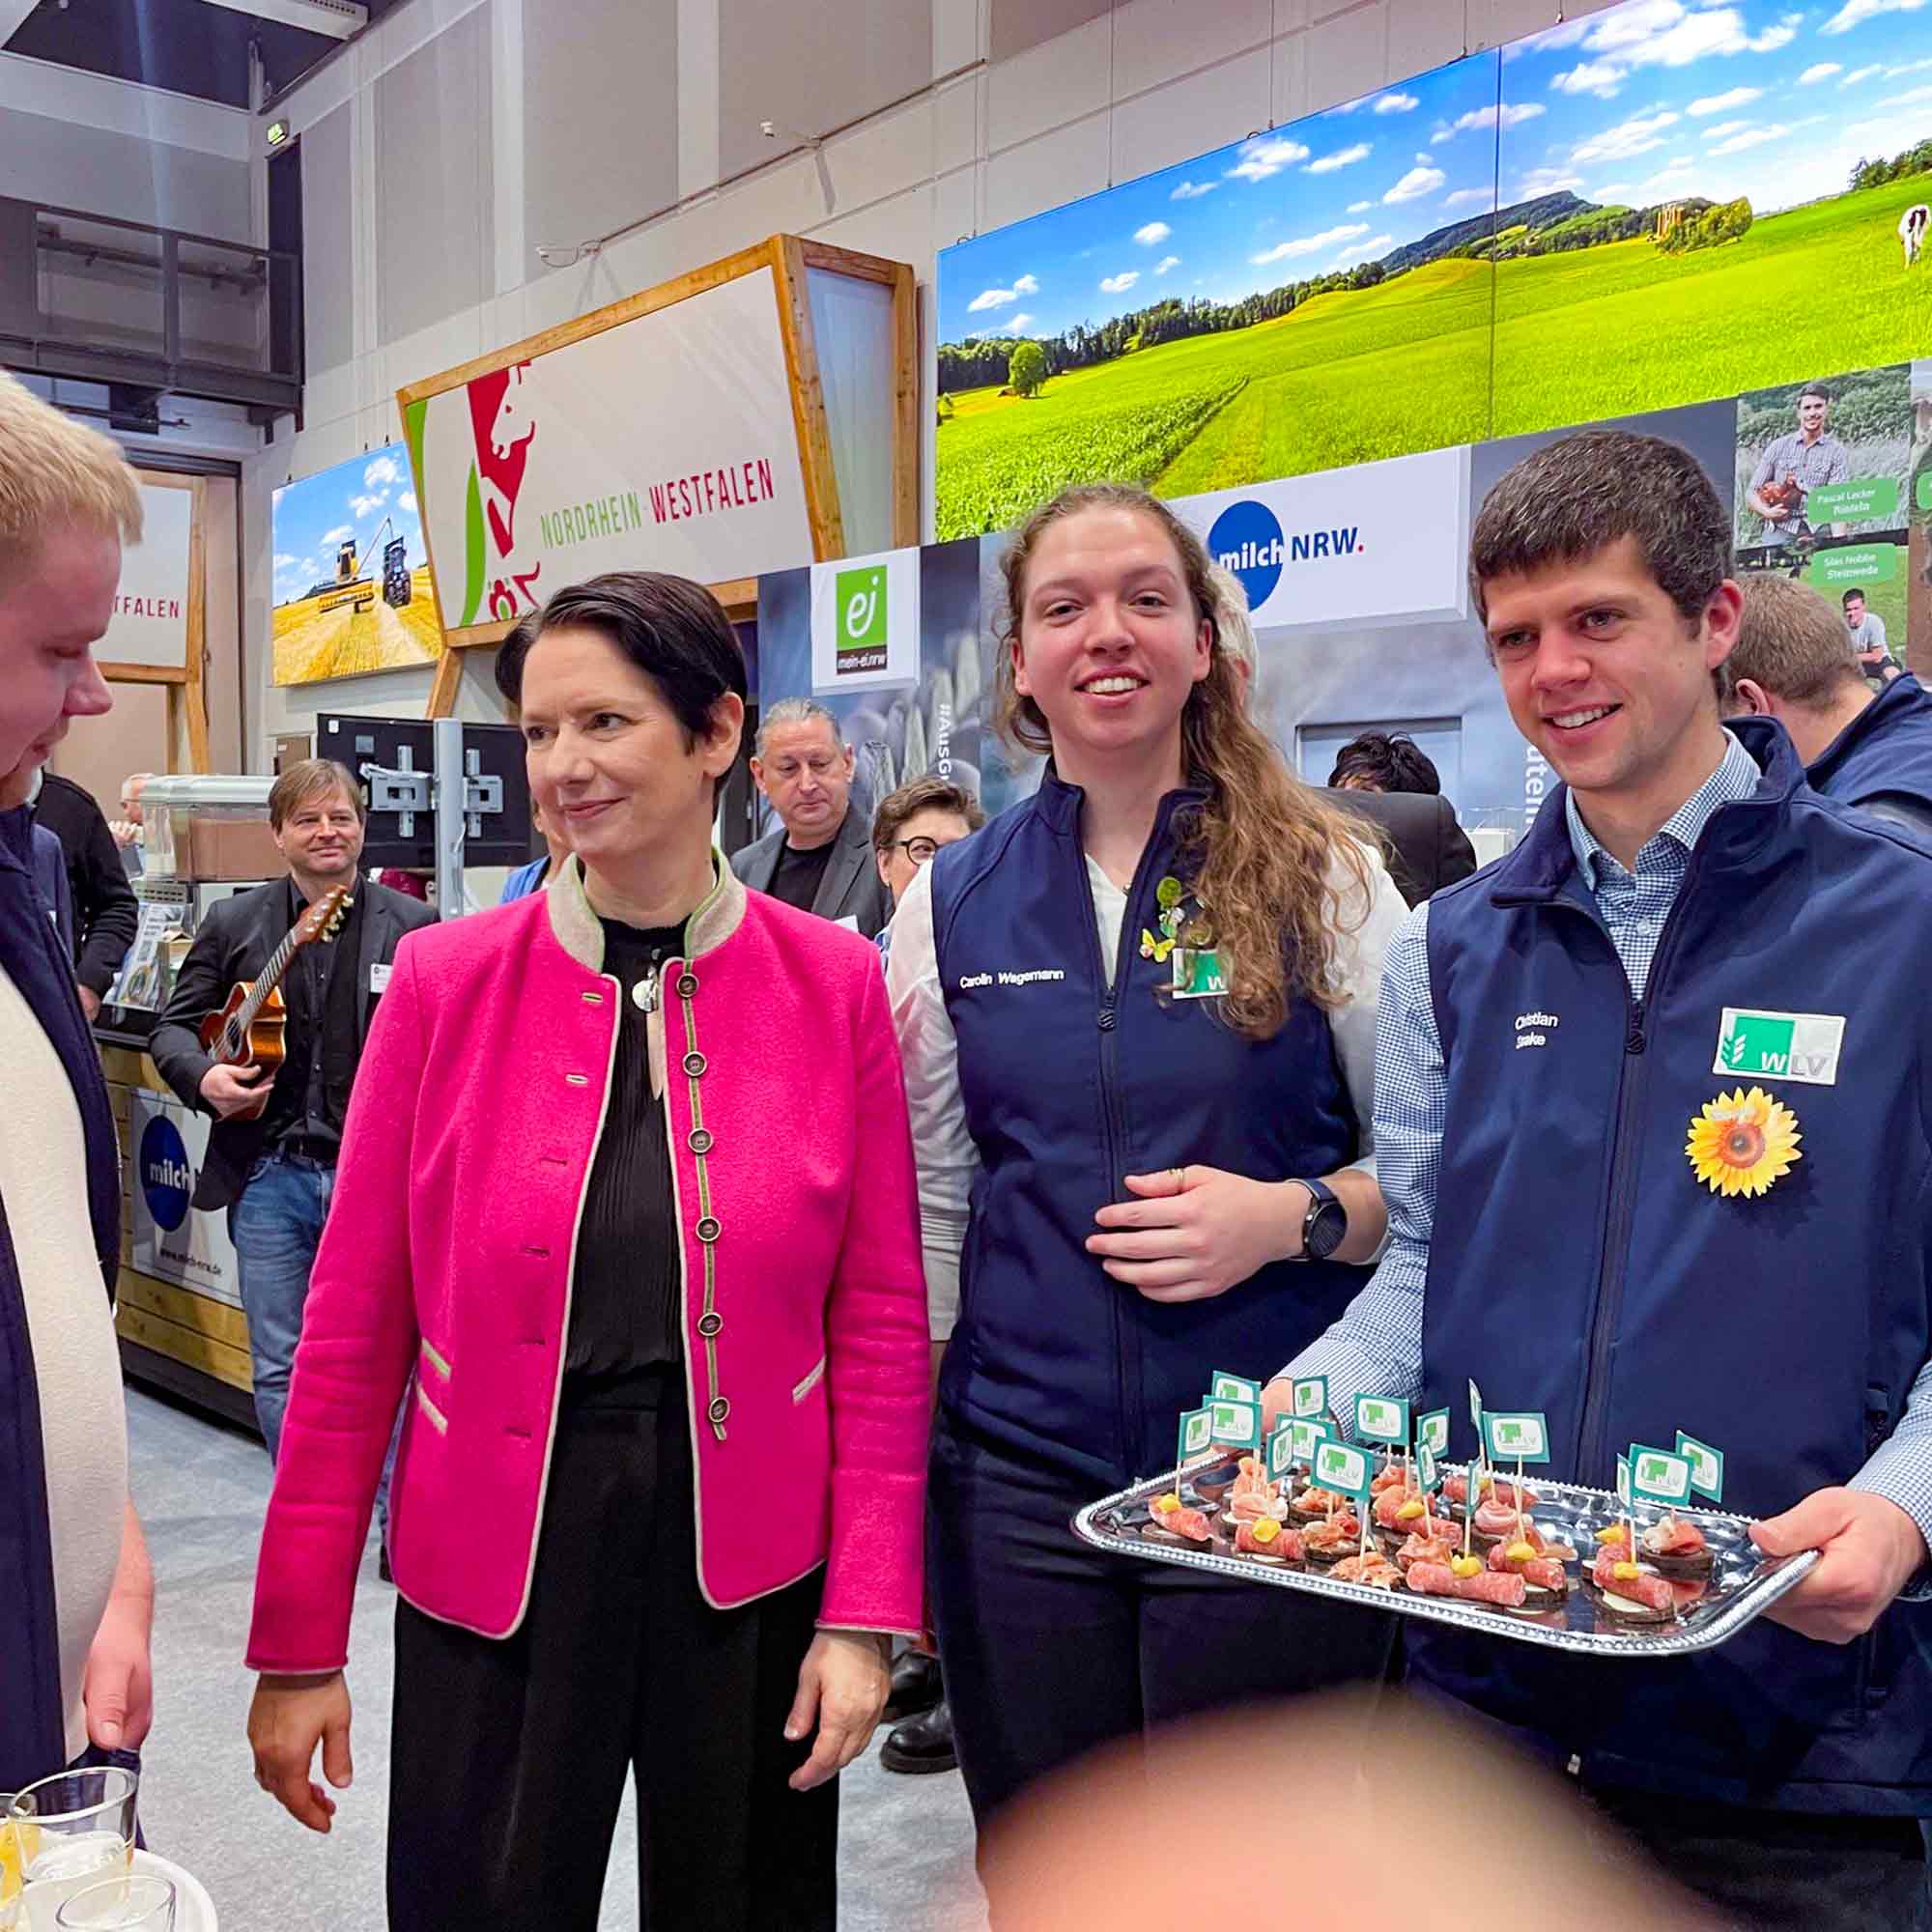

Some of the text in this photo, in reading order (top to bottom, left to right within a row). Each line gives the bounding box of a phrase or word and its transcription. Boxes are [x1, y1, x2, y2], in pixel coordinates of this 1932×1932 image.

[540, 458, 775, 549] NORDRHEIN WESTFALEN
[1218, 526, 1365, 572] milch NRW.
[113, 595, 179, 618] TFALEN
[1761, 1049, 1830, 1077] WLV
[149, 1158, 191, 1190] milch
